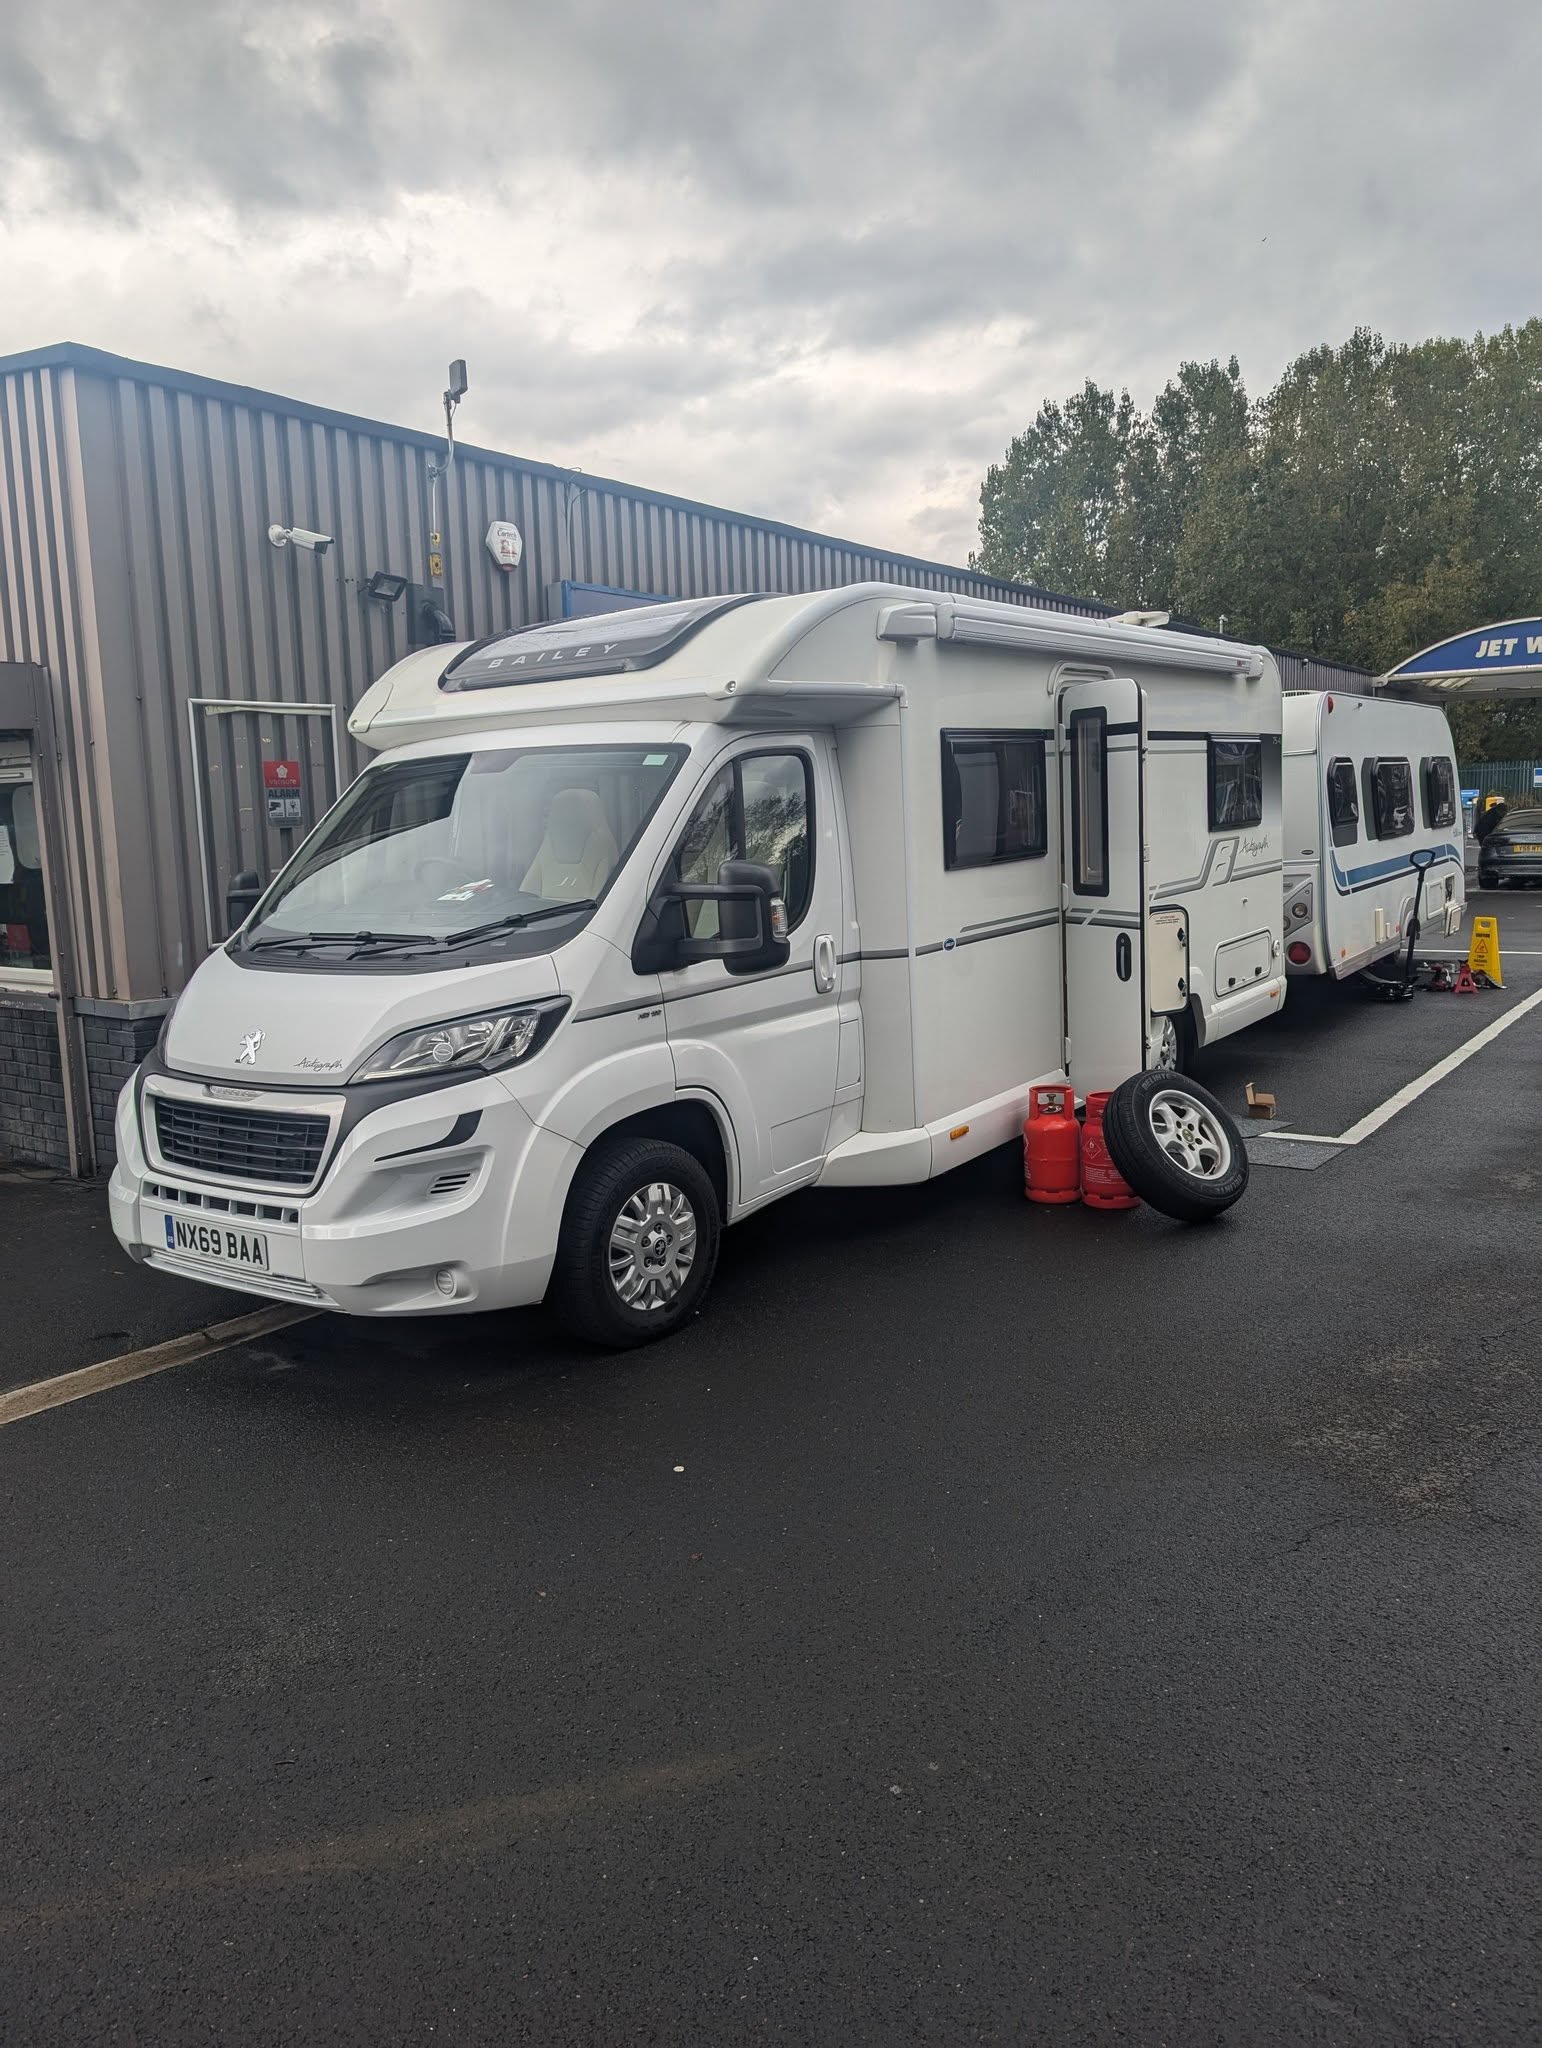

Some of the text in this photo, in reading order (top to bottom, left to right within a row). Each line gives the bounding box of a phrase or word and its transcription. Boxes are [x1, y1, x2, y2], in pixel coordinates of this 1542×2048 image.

[487, 643, 618, 669] BAILEY
[1475, 638, 1519, 658] JET
[268, 789, 301, 798] ALARM
[293, 1056, 343, 1072] Autograph
[175, 1221, 264, 1265] NX69 BAA
